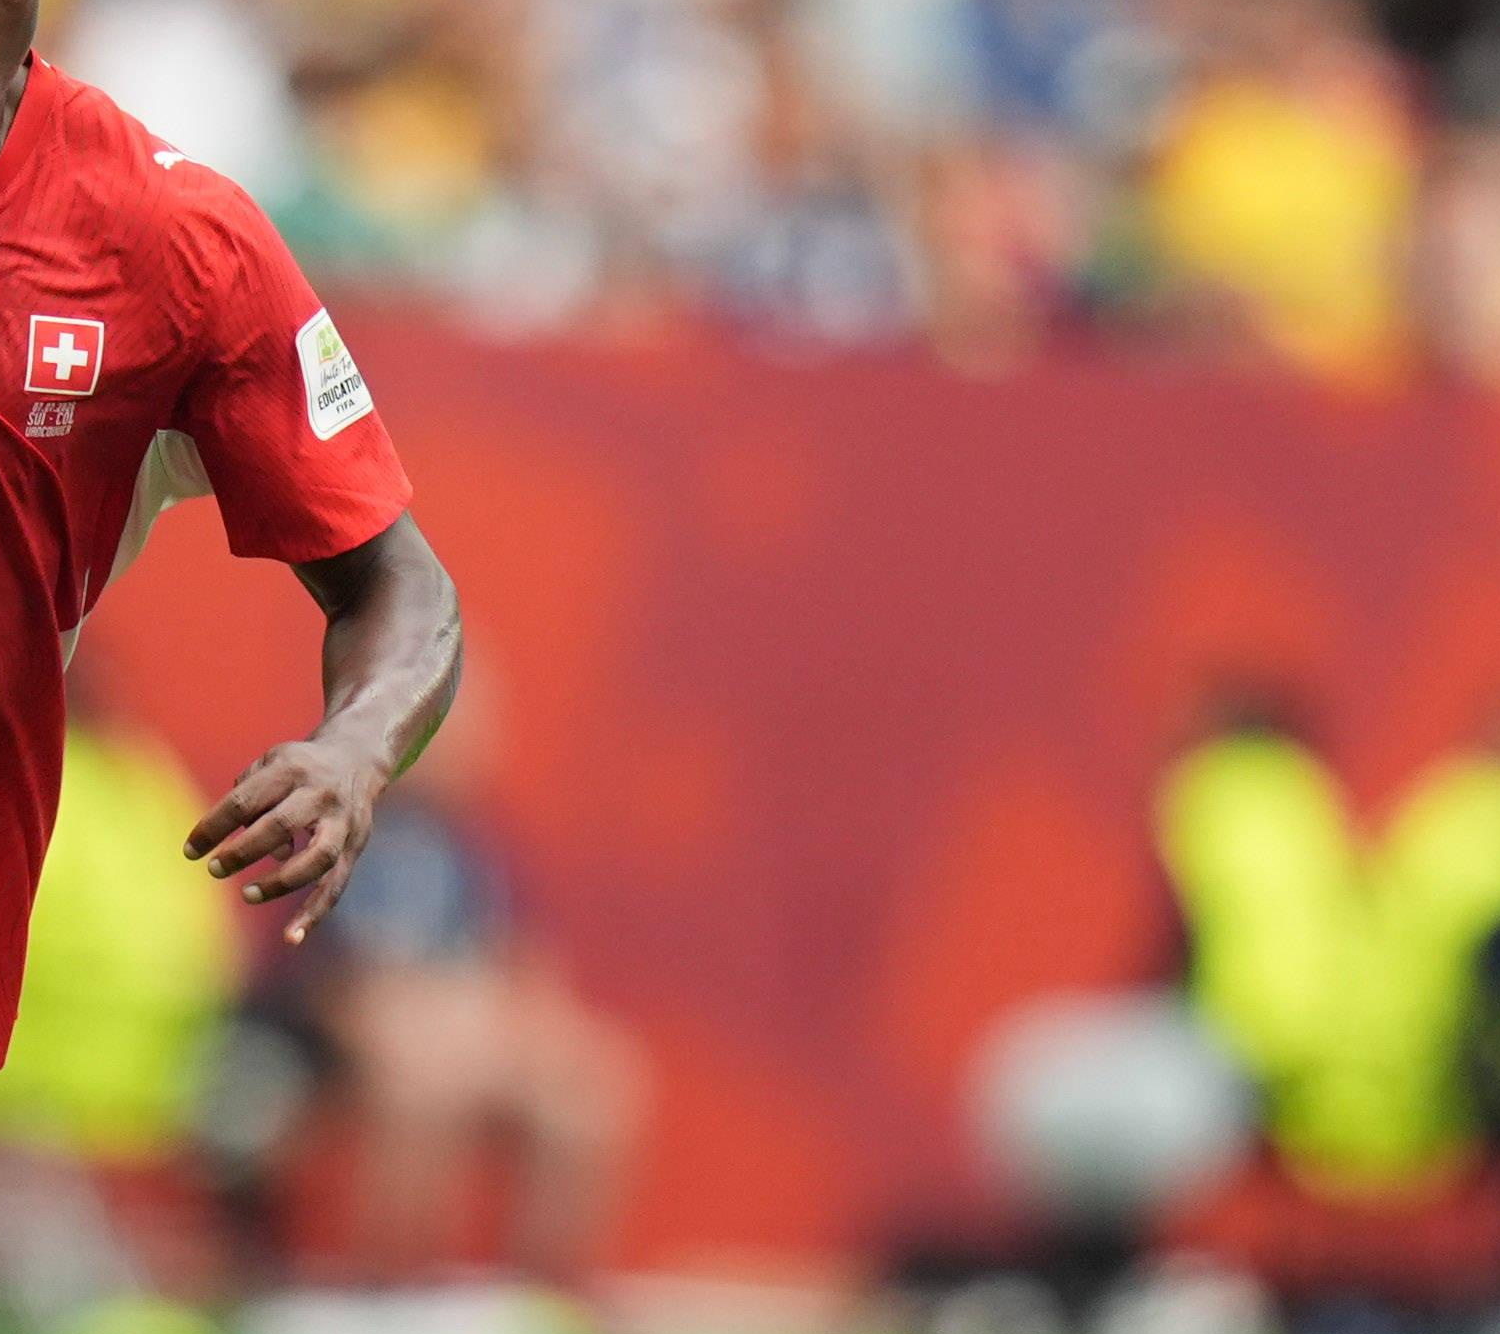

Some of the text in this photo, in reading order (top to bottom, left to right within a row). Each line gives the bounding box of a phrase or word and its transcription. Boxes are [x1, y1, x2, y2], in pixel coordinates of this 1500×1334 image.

[317, 374, 362, 411] EDUCATIO
[336, 398, 356, 414] FIFA
[27, 411, 46, 426] SUI
[55, 410, 75, 425] COL
